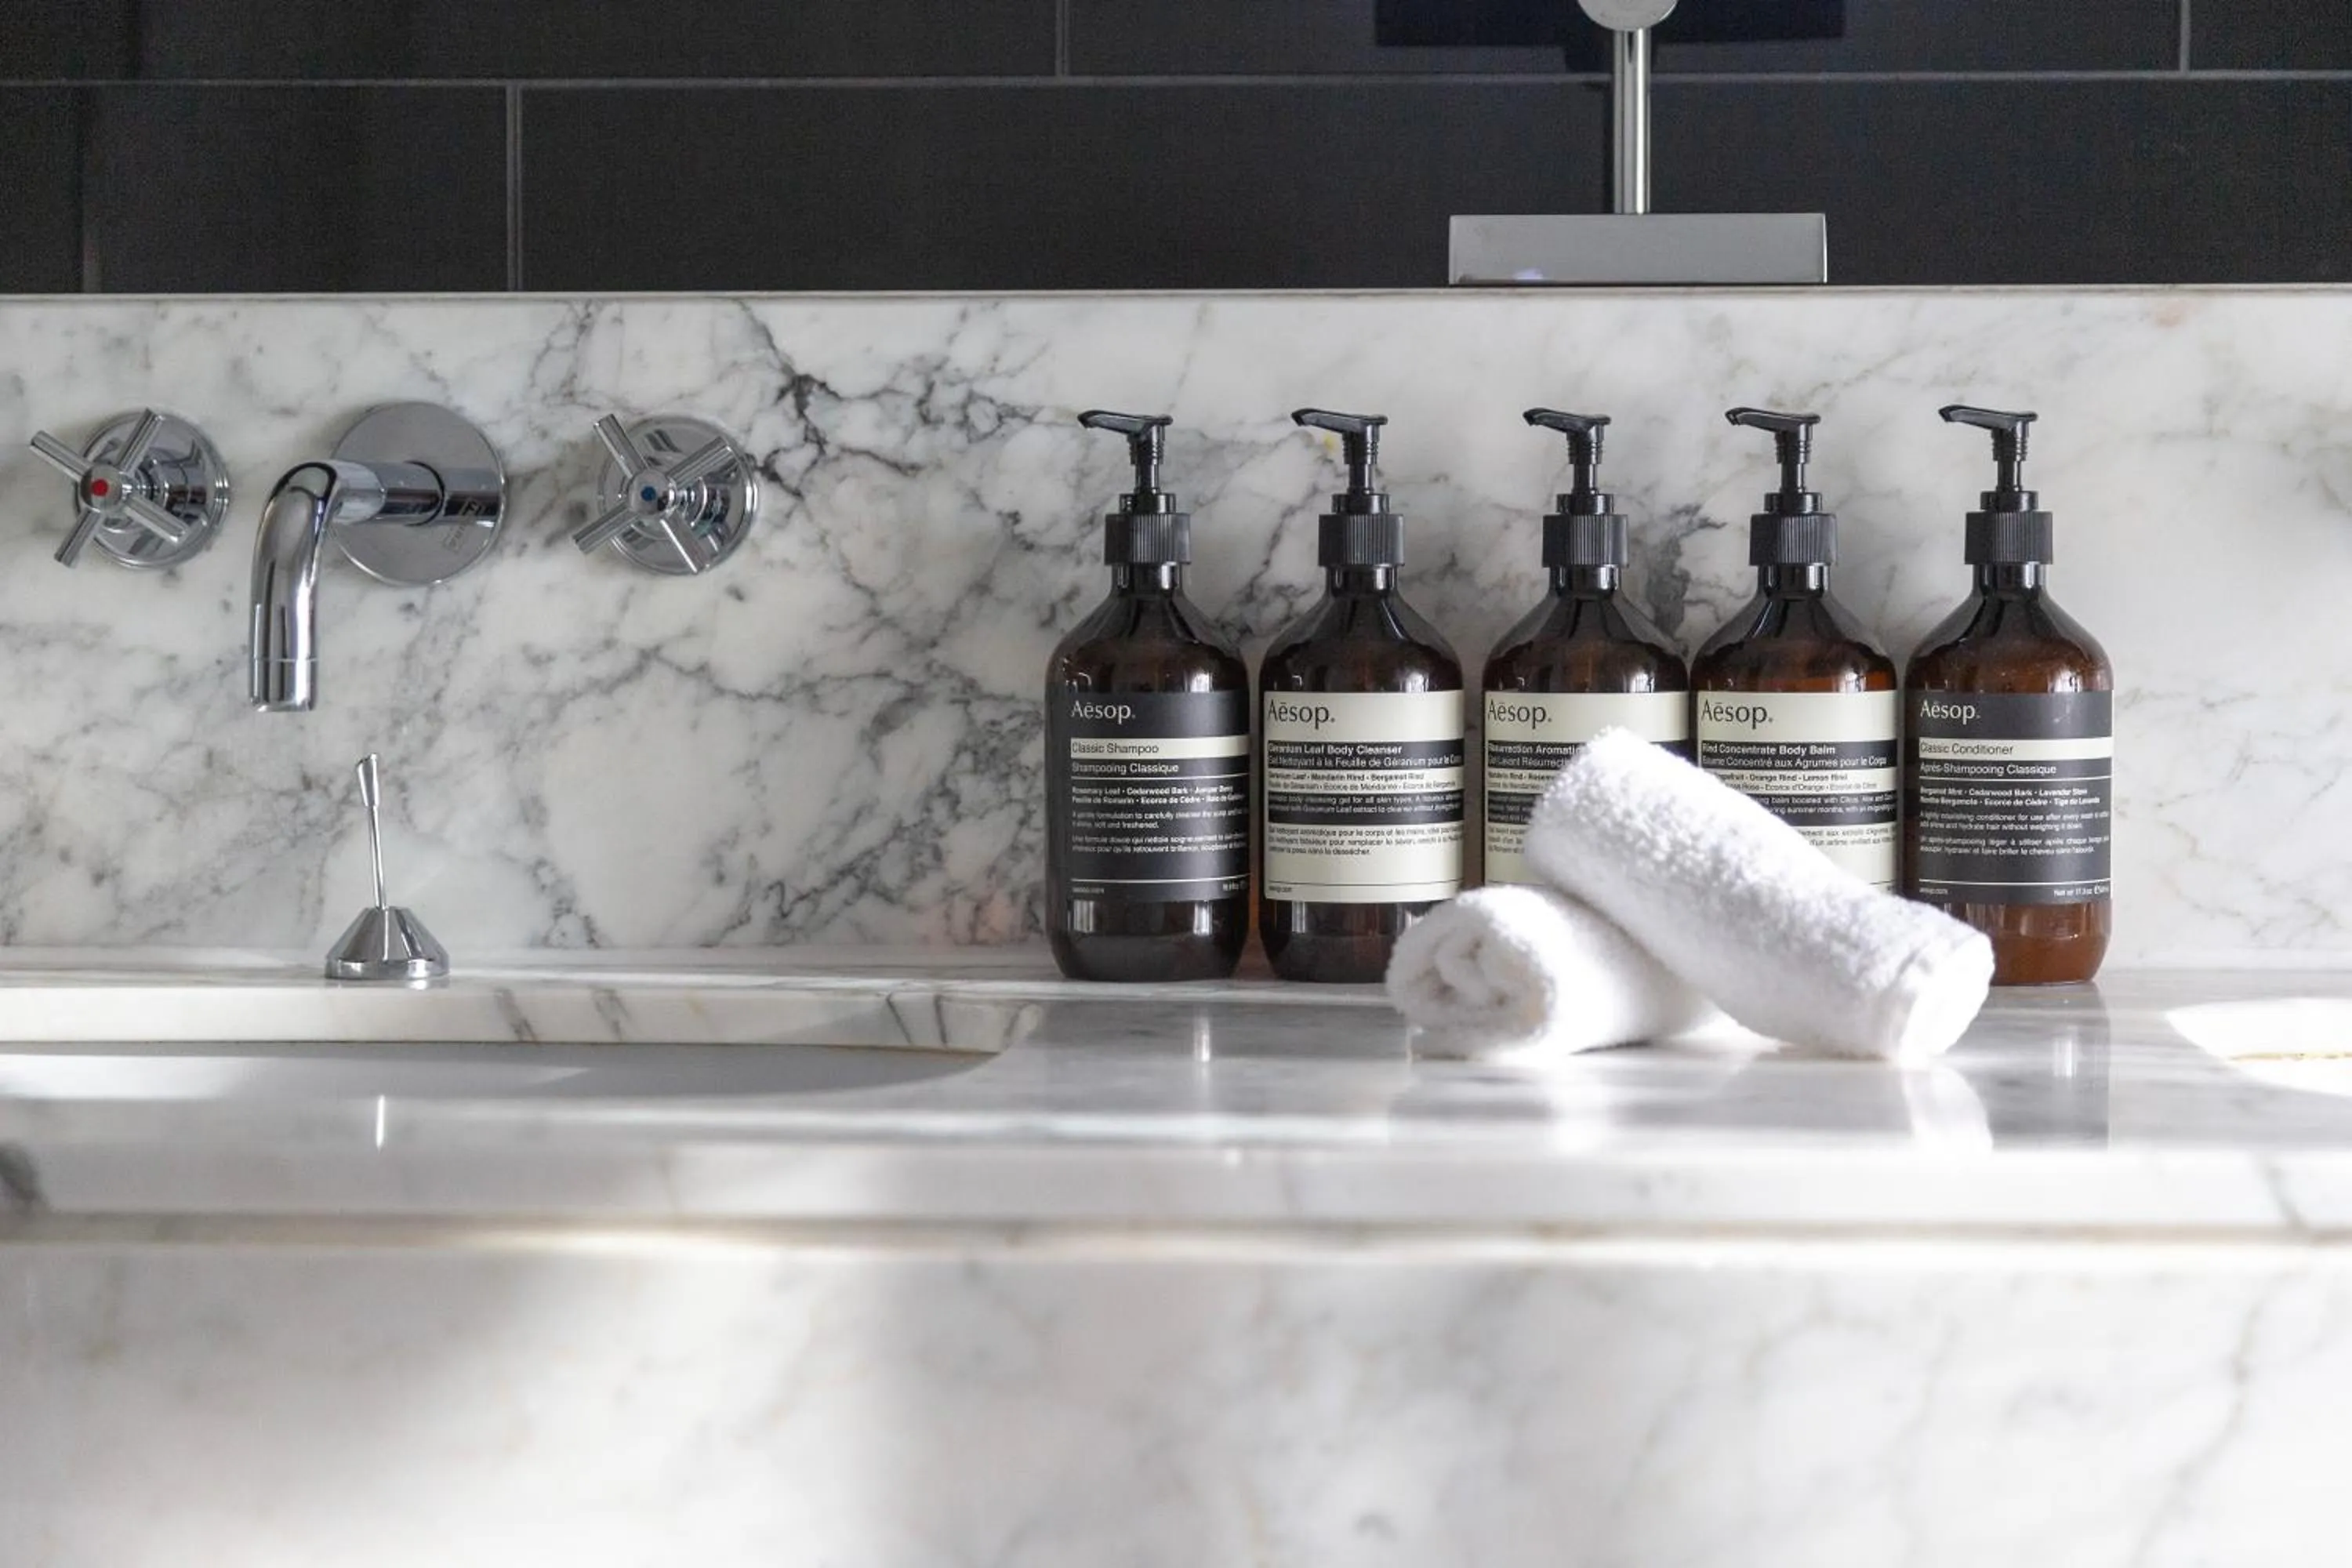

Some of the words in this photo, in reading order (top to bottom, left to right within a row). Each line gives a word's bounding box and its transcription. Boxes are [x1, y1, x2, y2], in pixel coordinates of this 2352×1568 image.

[1072, 742, 1105, 753] Classic
[1106, 742, 1160, 756] Shampoo
[1304, 744, 1325, 754] Leaf
[1327, 745, 1354, 757] Body
[1356, 745, 1403, 755] Cleanser
[1719, 744, 1777, 754] Concentrate
[1779, 745, 1806, 757] Body
[1809, 745, 1835, 755] Balm
[1921, 742, 1949, 753] Classic
[1951, 742, 2013, 755] Conditioner
[1072, 761, 1127, 775] Shampooing
[1130, 763, 1180, 775] Classique
[1324, 757, 1333, 766] la
[1335, 757, 1367, 768] Feuille
[1368, 757, 1381, 768] de
[1726, 756, 1772, 768] Concentré
[1774, 758, 1793, 768] aux
[1795, 758, 1838, 769] Agrumes
[1840, 757, 1860, 768] pour
[1860, 756, 1867, 766] le
[2007, 764, 2056, 776] Classique
